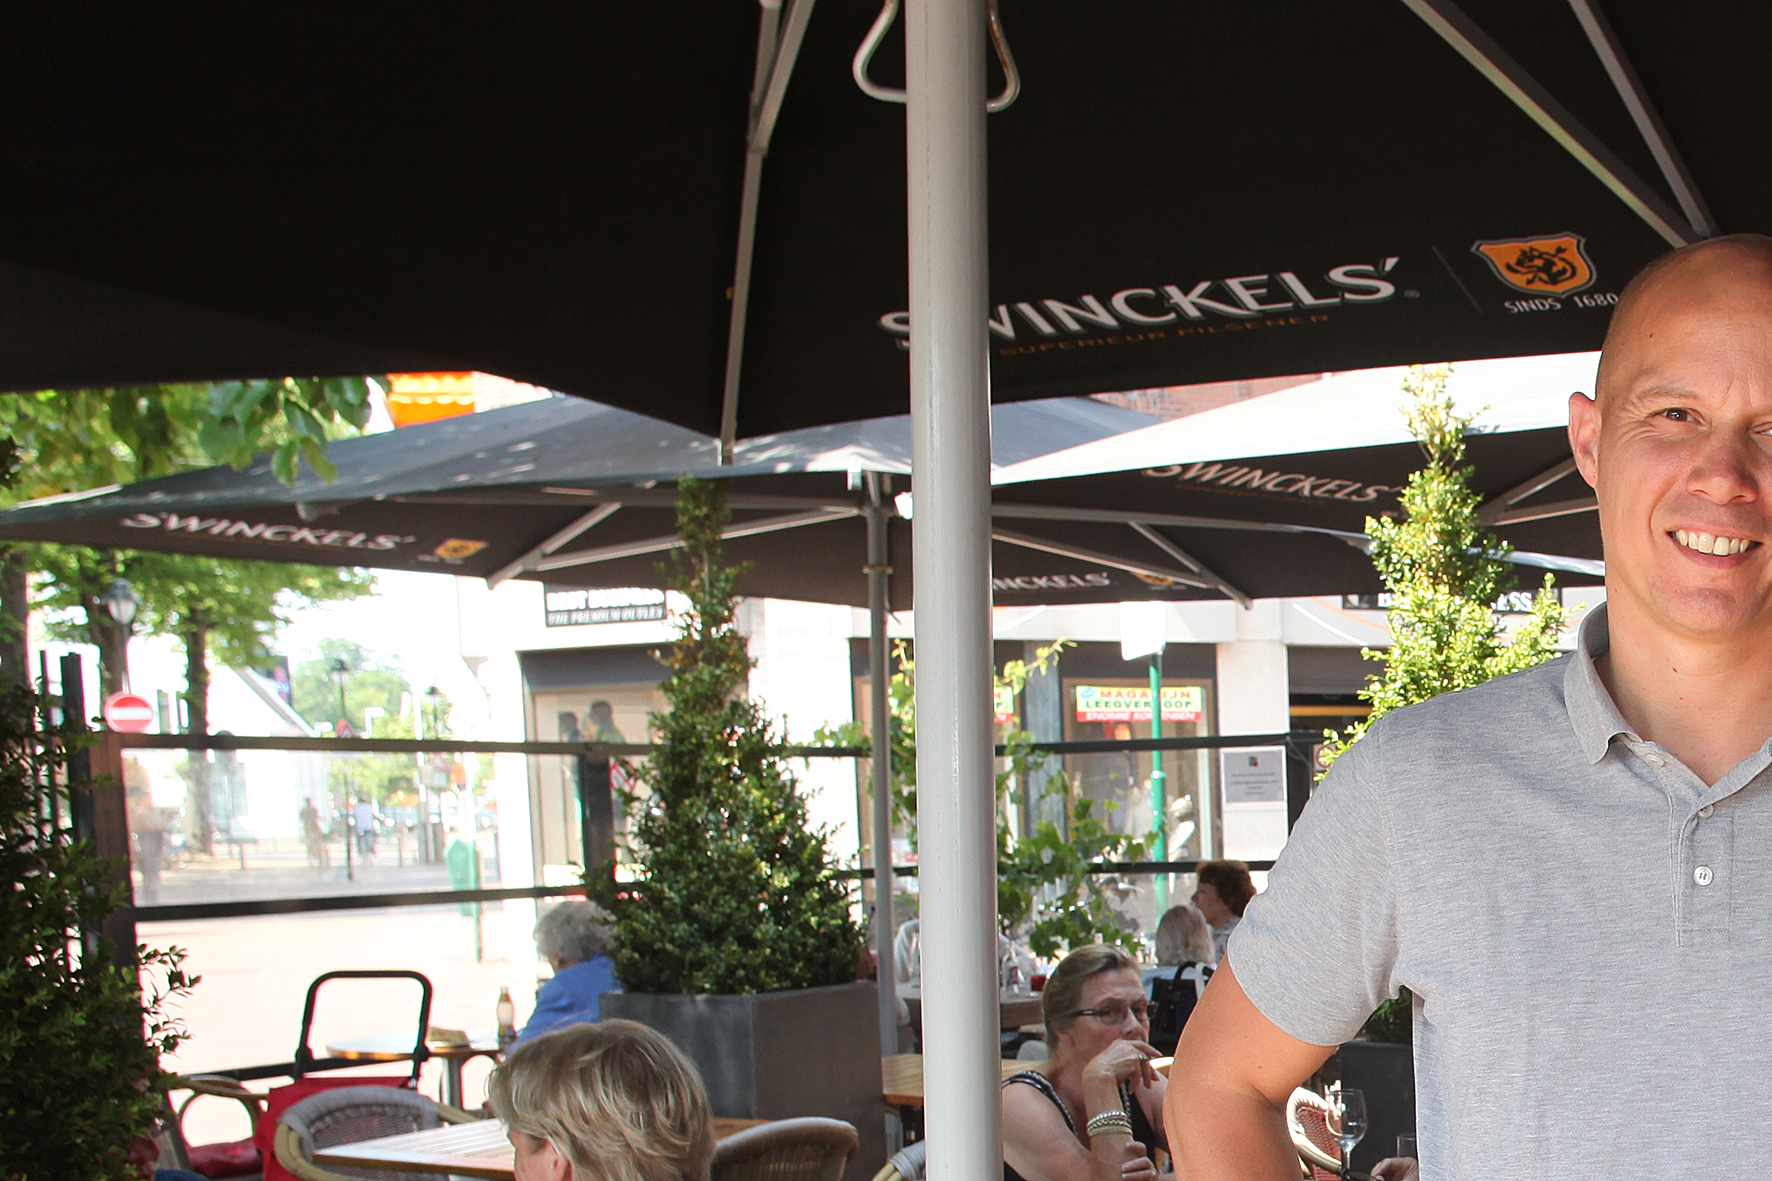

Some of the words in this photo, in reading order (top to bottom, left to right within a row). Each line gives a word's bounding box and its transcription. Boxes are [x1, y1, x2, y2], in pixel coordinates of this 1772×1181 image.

[1504, 297, 1562, 315] SINDS
[1573, 292, 1620, 310] 1680
[1100, 690, 1191, 699] MAGAIJN
[1085, 699, 1193, 709] LEEGVEROOP
